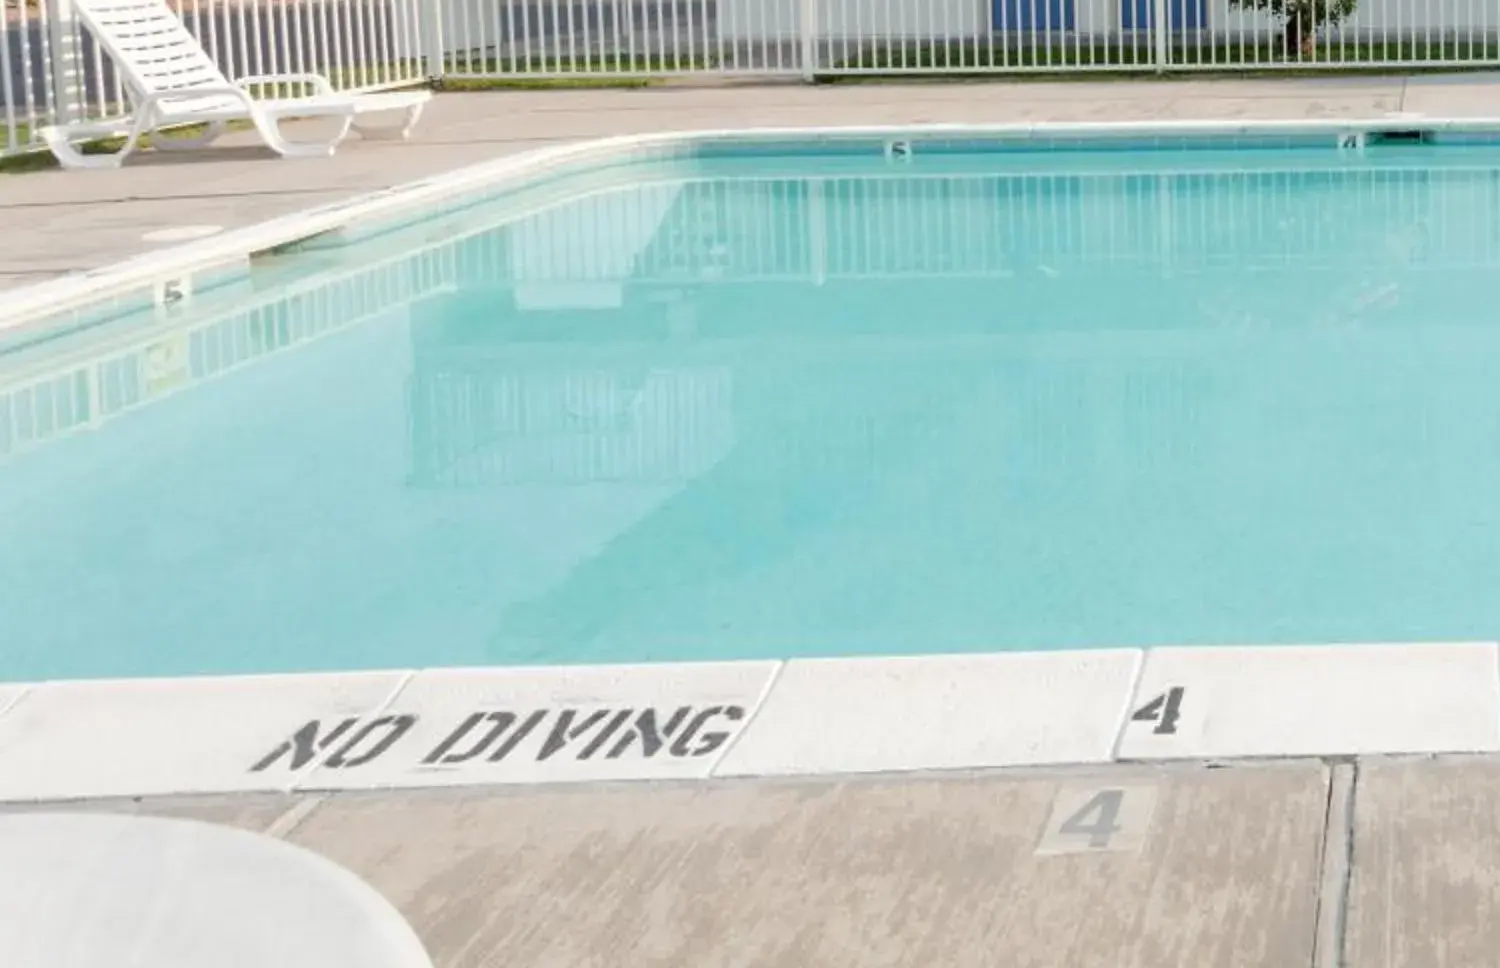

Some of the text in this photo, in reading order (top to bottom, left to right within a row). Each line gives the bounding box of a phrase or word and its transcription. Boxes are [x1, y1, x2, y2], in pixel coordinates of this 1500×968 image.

[249, 704, 745, 772] NO DIVING
[1131, 686, 1185, 734] 4
[1058, 790, 1124, 848] 4
